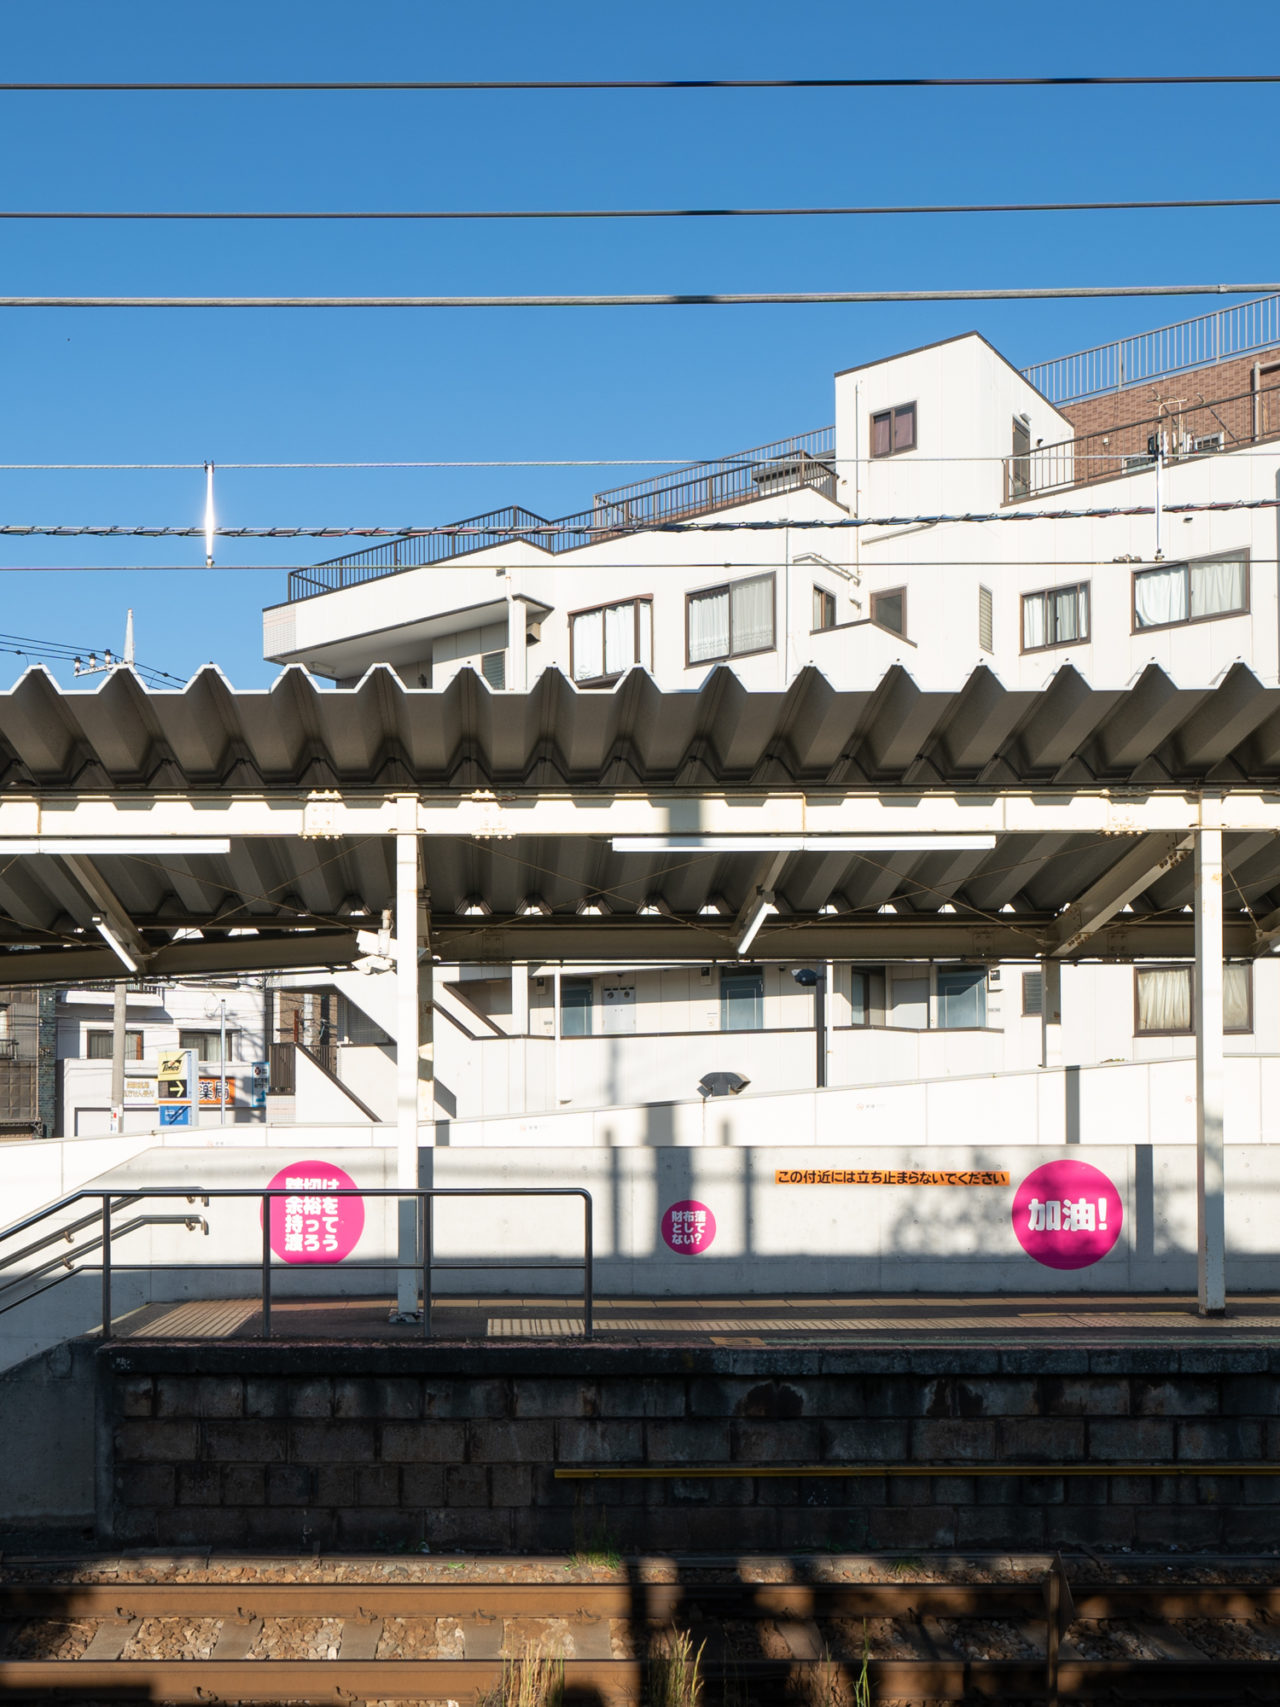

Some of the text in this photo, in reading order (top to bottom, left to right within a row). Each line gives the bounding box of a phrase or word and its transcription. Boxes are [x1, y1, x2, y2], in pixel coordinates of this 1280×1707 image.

[199, 1081, 229, 1100] 薬局
[778, 1170, 1006, 1185] この付近には立ち止まらないでください
[285, 1196, 338, 1215] 余裕を
[285, 1214, 339, 1233] 持って
[672, 1210, 706, 1222] 財布落
[1028, 1198, 1107, 1232] 加油!
[672, 1223, 706, 1233] として
[285, 1233, 338, 1251] 渡ろう
[672, 1233, 702, 1245] ない?
